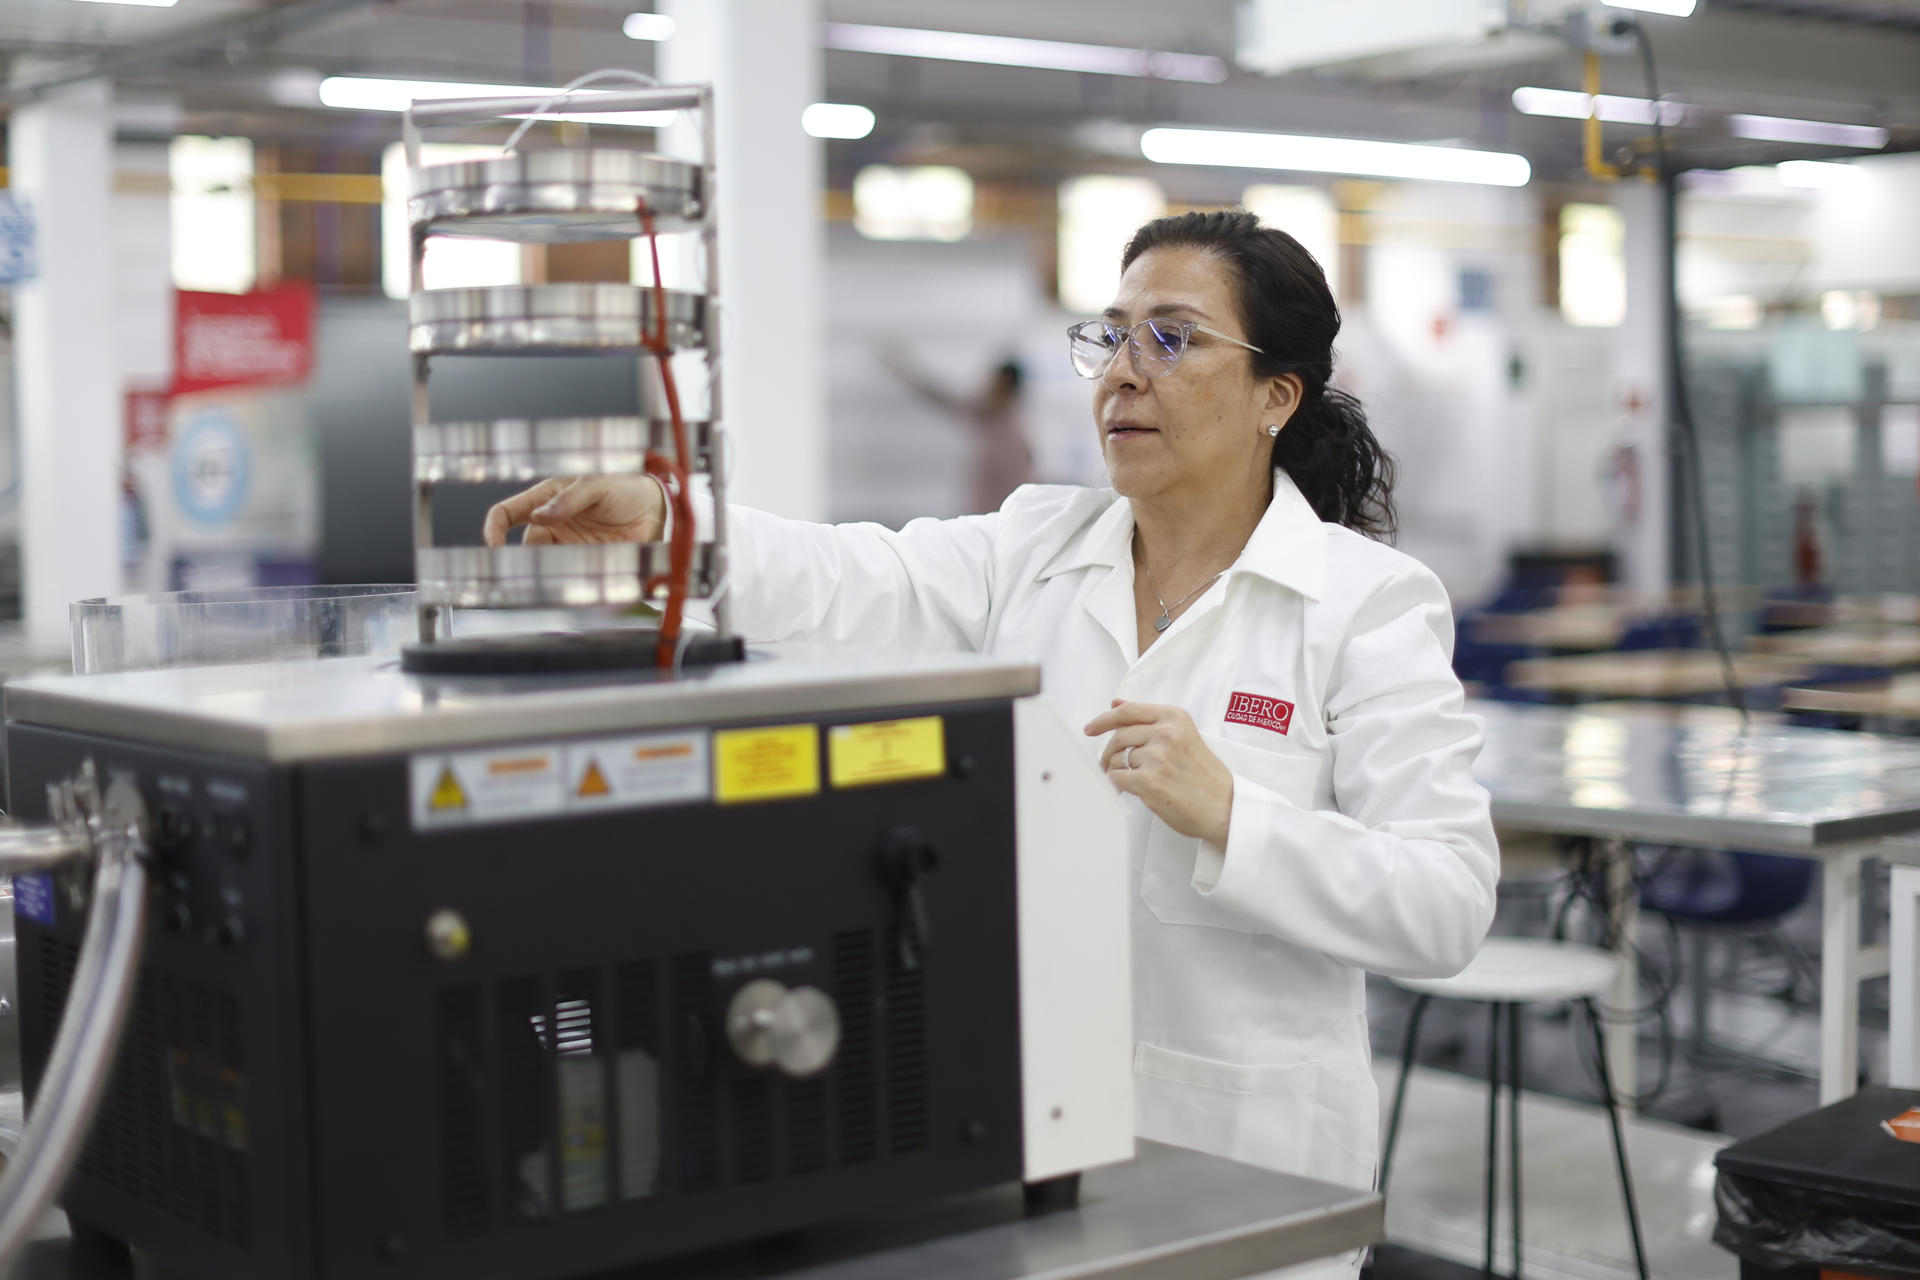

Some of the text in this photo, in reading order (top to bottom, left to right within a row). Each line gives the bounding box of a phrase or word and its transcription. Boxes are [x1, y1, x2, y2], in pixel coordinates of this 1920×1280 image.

[1230, 694, 1289, 721] IBERO
[1227, 712, 1248, 722] CIUDAD
[1248, 715, 1257, 723] DE
